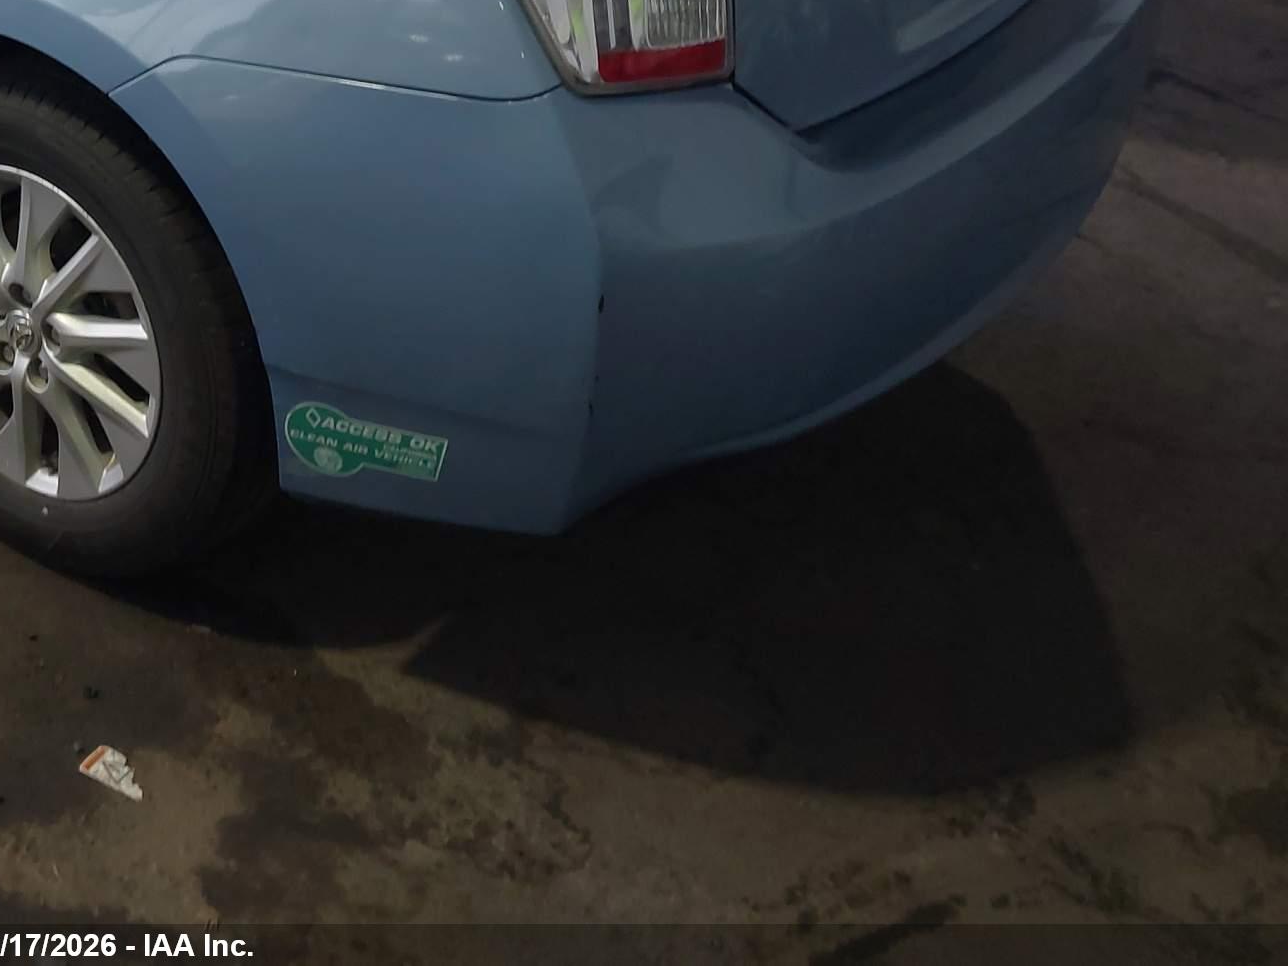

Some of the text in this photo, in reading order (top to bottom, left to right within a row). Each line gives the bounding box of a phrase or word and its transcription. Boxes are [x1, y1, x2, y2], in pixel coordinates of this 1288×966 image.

[290, 429, 338, 448] CLEAN
[343, 442, 369, 456] AIR
[321, 417, 402, 445] ACCESS
[410, 436, 438, 453] OK
